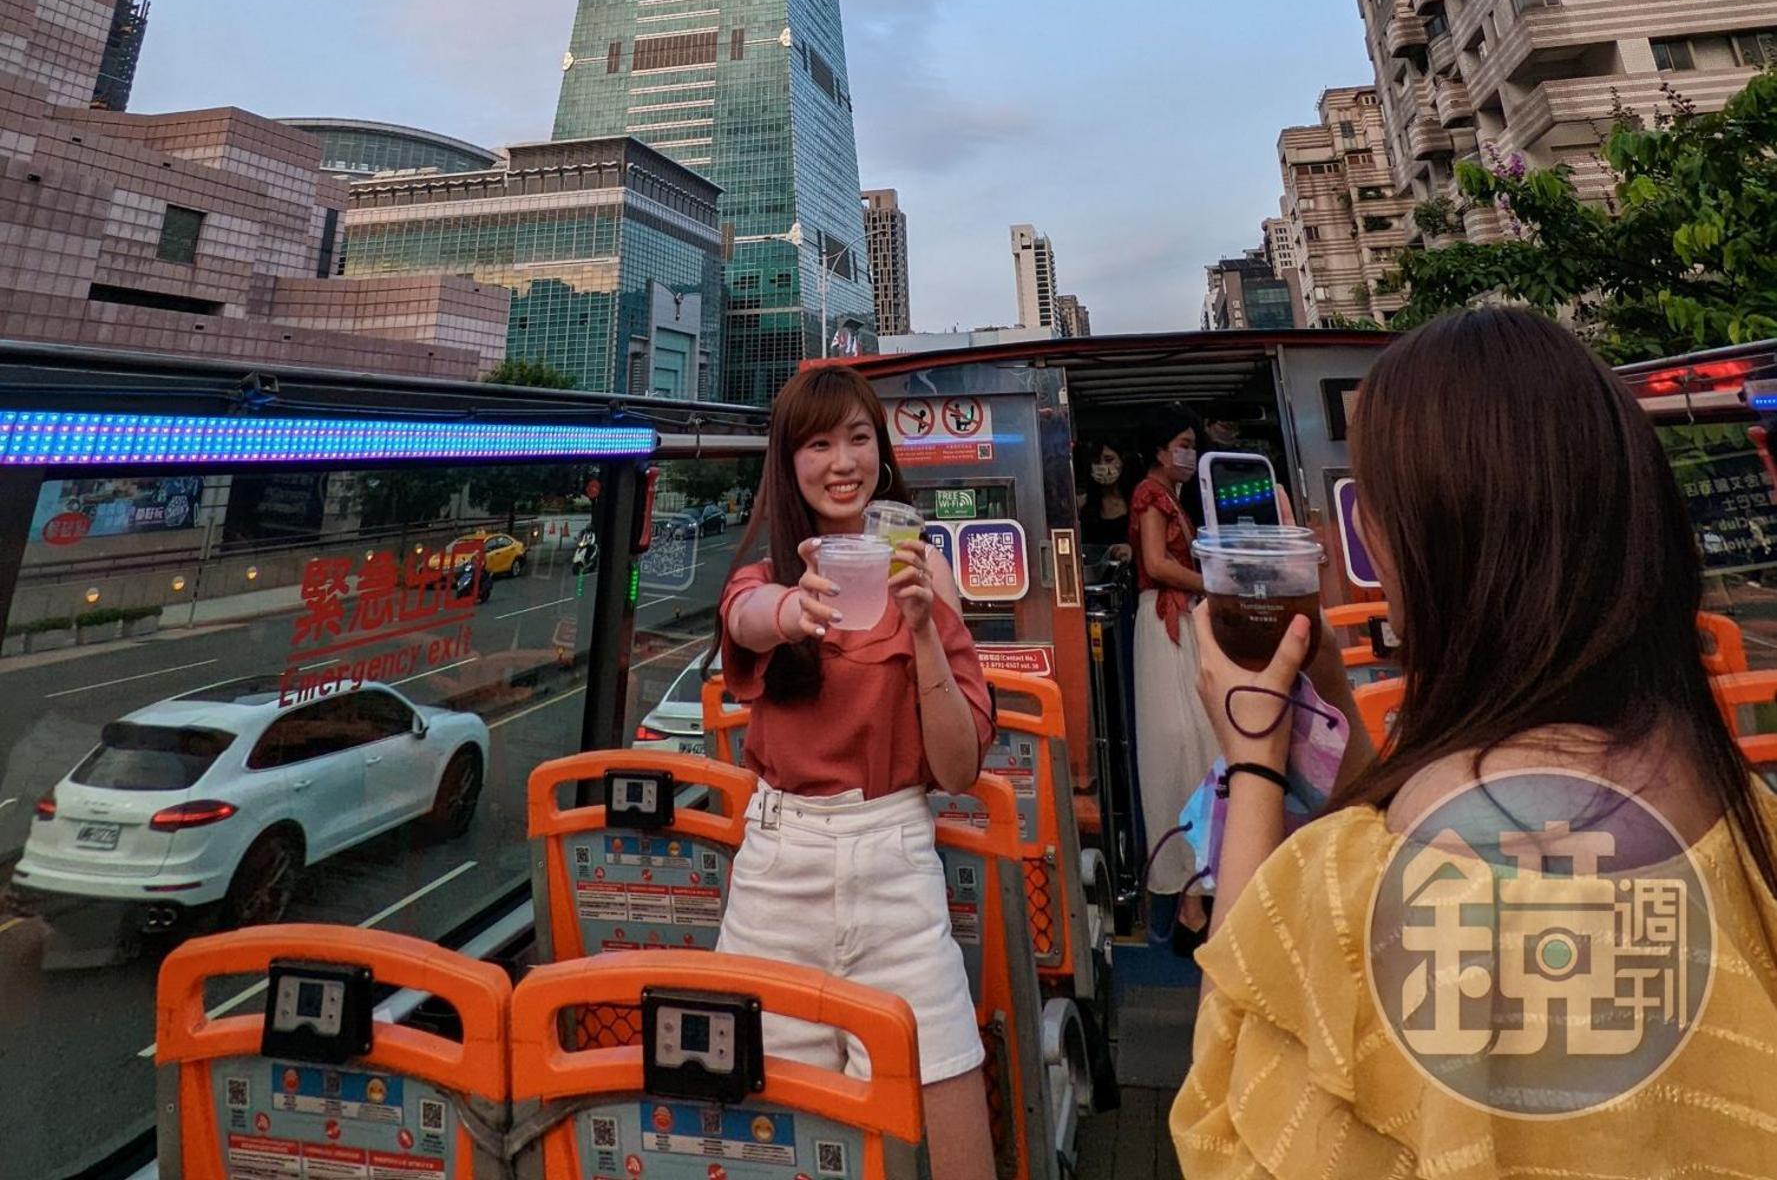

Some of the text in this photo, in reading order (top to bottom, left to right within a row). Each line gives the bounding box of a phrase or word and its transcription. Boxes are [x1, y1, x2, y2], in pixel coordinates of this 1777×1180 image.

[937, 491, 959, 500] FREE
[291, 539, 486, 645] 緊急出口
[278, 625, 473, 708] Emergency exit
